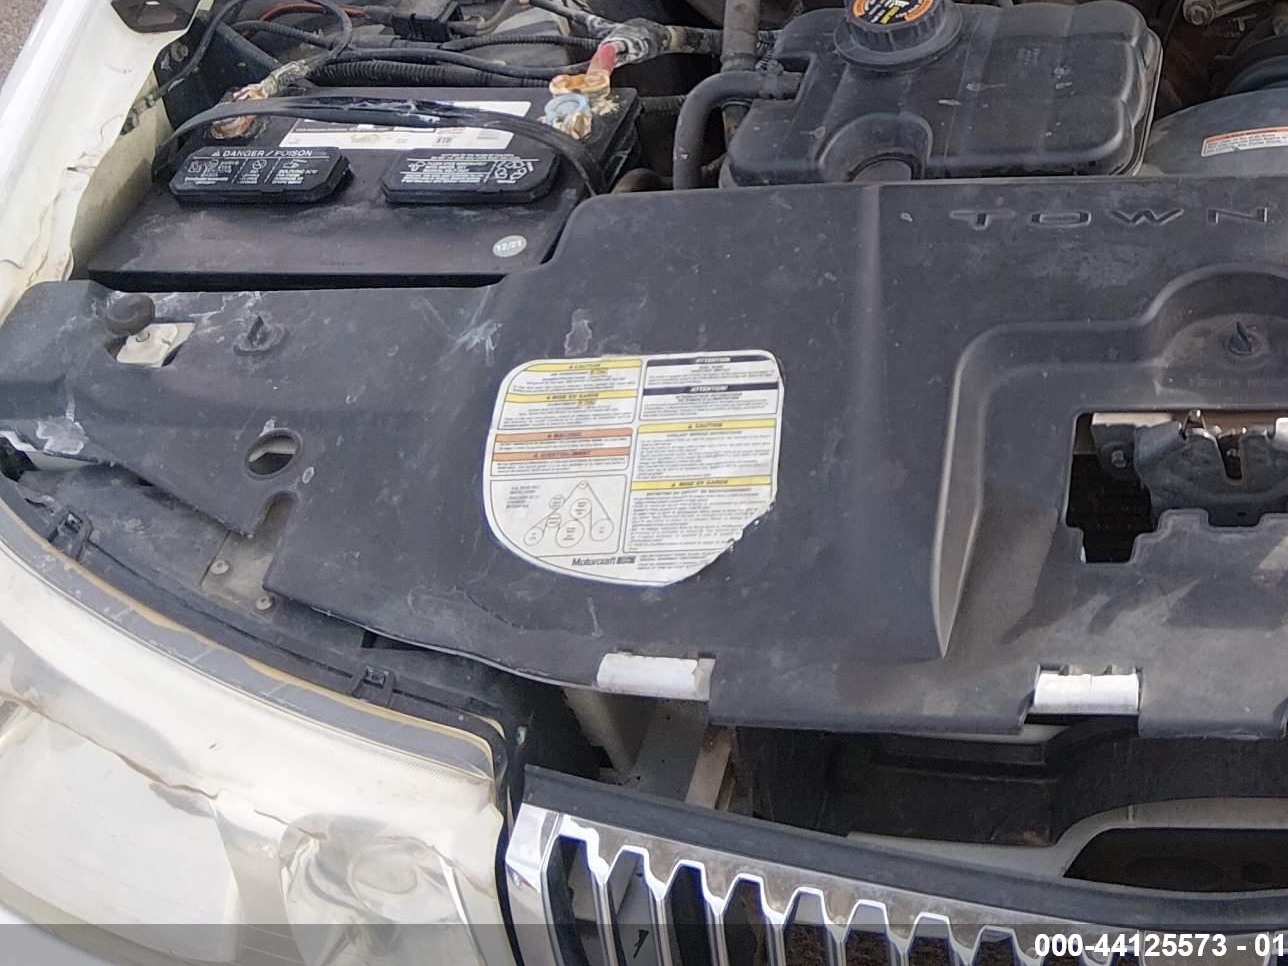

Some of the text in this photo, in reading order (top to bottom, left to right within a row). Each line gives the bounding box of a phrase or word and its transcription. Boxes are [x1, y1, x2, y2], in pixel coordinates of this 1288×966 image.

[223, 149, 264, 157] DANGER
[274, 149, 313, 157] POISON
[949, 205, 1269, 230] TOWN
[572, 556, 617, 566] Motorcraft
